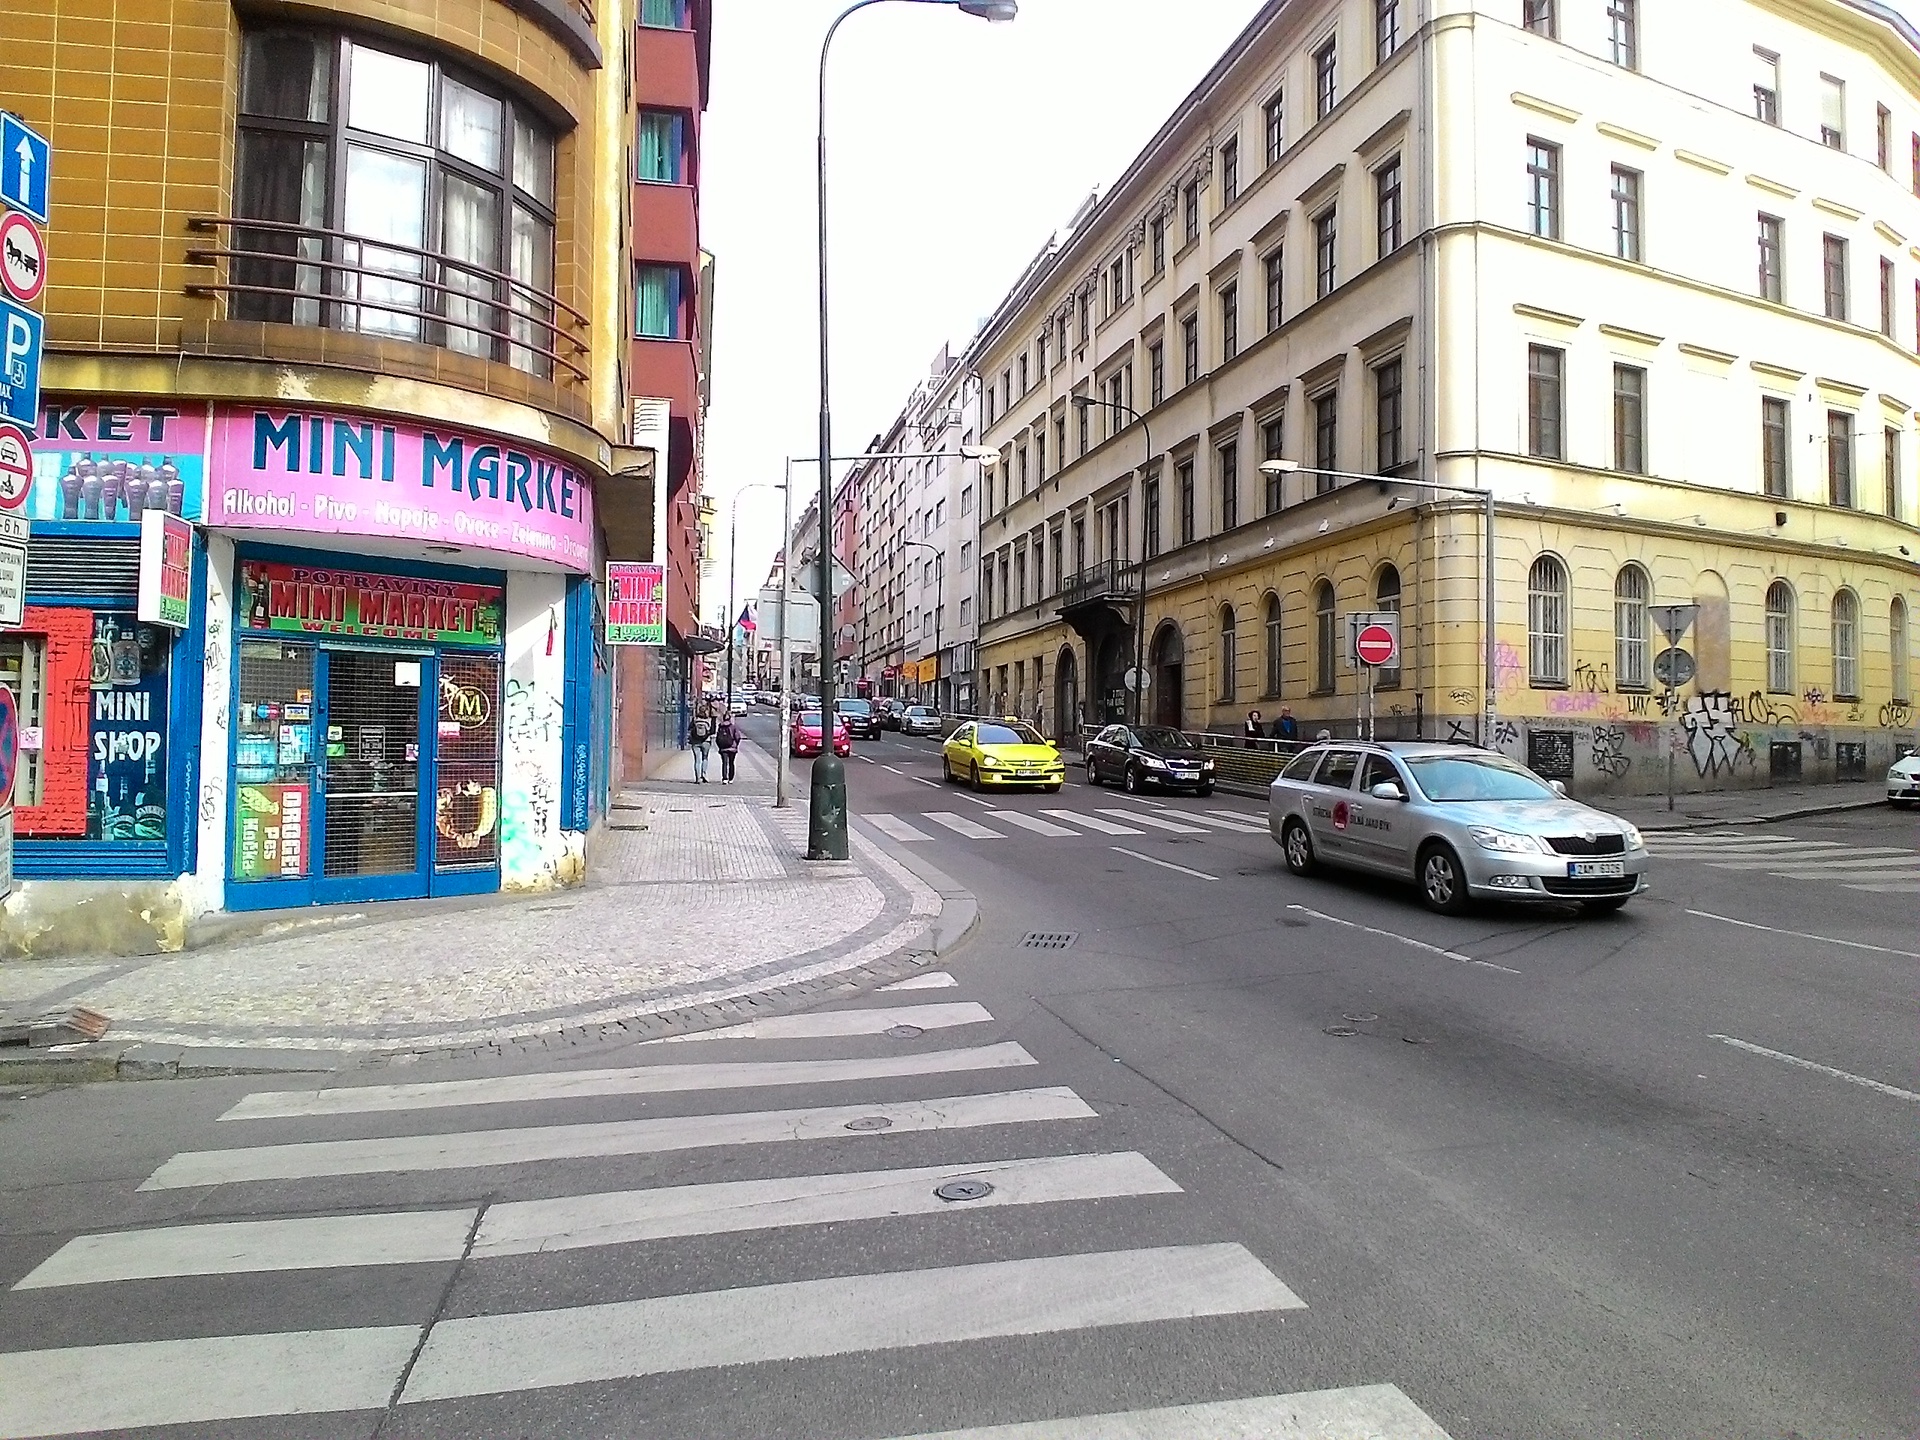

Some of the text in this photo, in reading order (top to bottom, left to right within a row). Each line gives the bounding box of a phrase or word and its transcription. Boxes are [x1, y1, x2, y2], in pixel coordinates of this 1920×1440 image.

[5, 312, 31, 375] P
[21, 404, 180, 443] KET
[253, 411, 588, 524] MINI MARKET
[223, 488, 295, 517] Alkohol
[314, 495, 356, 521] Pivo
[374, 501, 438, 534] Napoje
[453, 511, 500, 539] Ovoce
[292, 569, 459, 597] POTRAVINY
[620, 577, 652, 600] MINI
[269, 580, 479, 634] MINI MARKET
[609, 602, 663, 625] MARKET
[302, 622, 439, 640] WELCOME
[95, 692, 150, 720] MINI
[458, 693, 481, 715] M
[94, 731, 161, 763] SHOP
